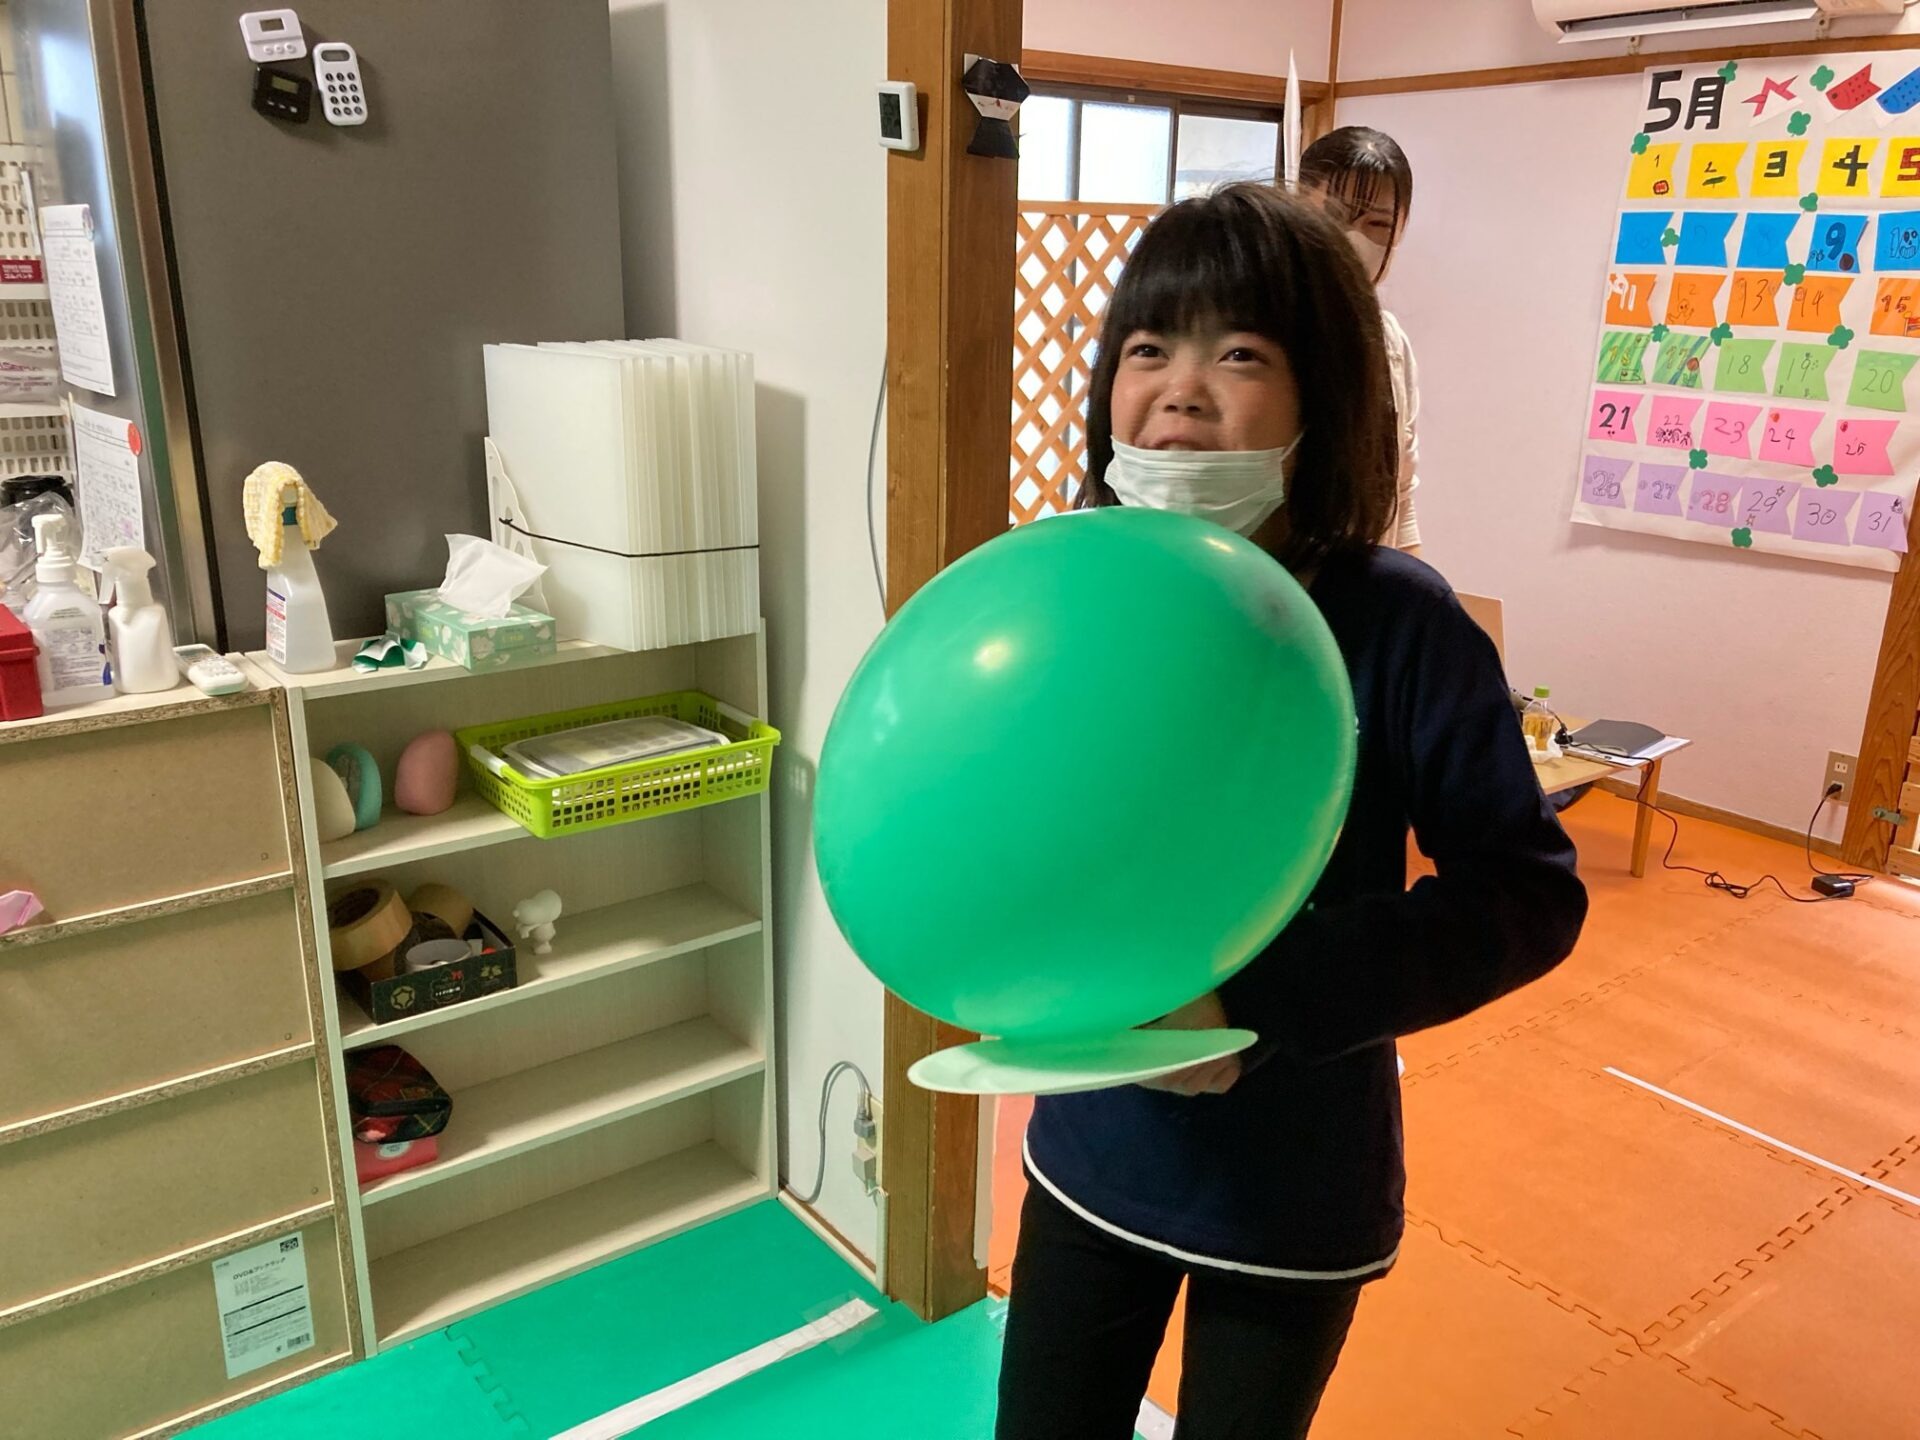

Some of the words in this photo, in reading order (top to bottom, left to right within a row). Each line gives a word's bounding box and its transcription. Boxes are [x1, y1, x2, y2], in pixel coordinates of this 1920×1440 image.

[1643, 69, 1726, 134] 5月
[1653, 154, 1661, 169] 1
[1703, 160, 1717, 173] 2
[1763, 150, 1788, 178] 3
[1832, 144, 1869, 187] 4
[1896, 147, 1920, 181] 5
[1826, 222, 1847, 260] 9
[1881, 294, 1912, 313] 15
[1726, 354, 1752, 375] 18
[1785, 355, 1812, 383] 19
[1861, 368, 1896, 395] 20
[1598, 402, 1631, 431] 21
[1663, 414, 1684, 426] 22
[1714, 417, 1745, 444] 23
[1768, 427, 1796, 450] 24
[1844, 442, 1866, 457] 25
[1592, 470, 1621, 499] 26
[1651, 480, 1677, 501] 27
[1701, 489, 1730, 514] 28
[1746, 490, 1779, 513] 29
[1807, 502, 1838, 526] 30
[1868, 511, 1892, 533] 31
